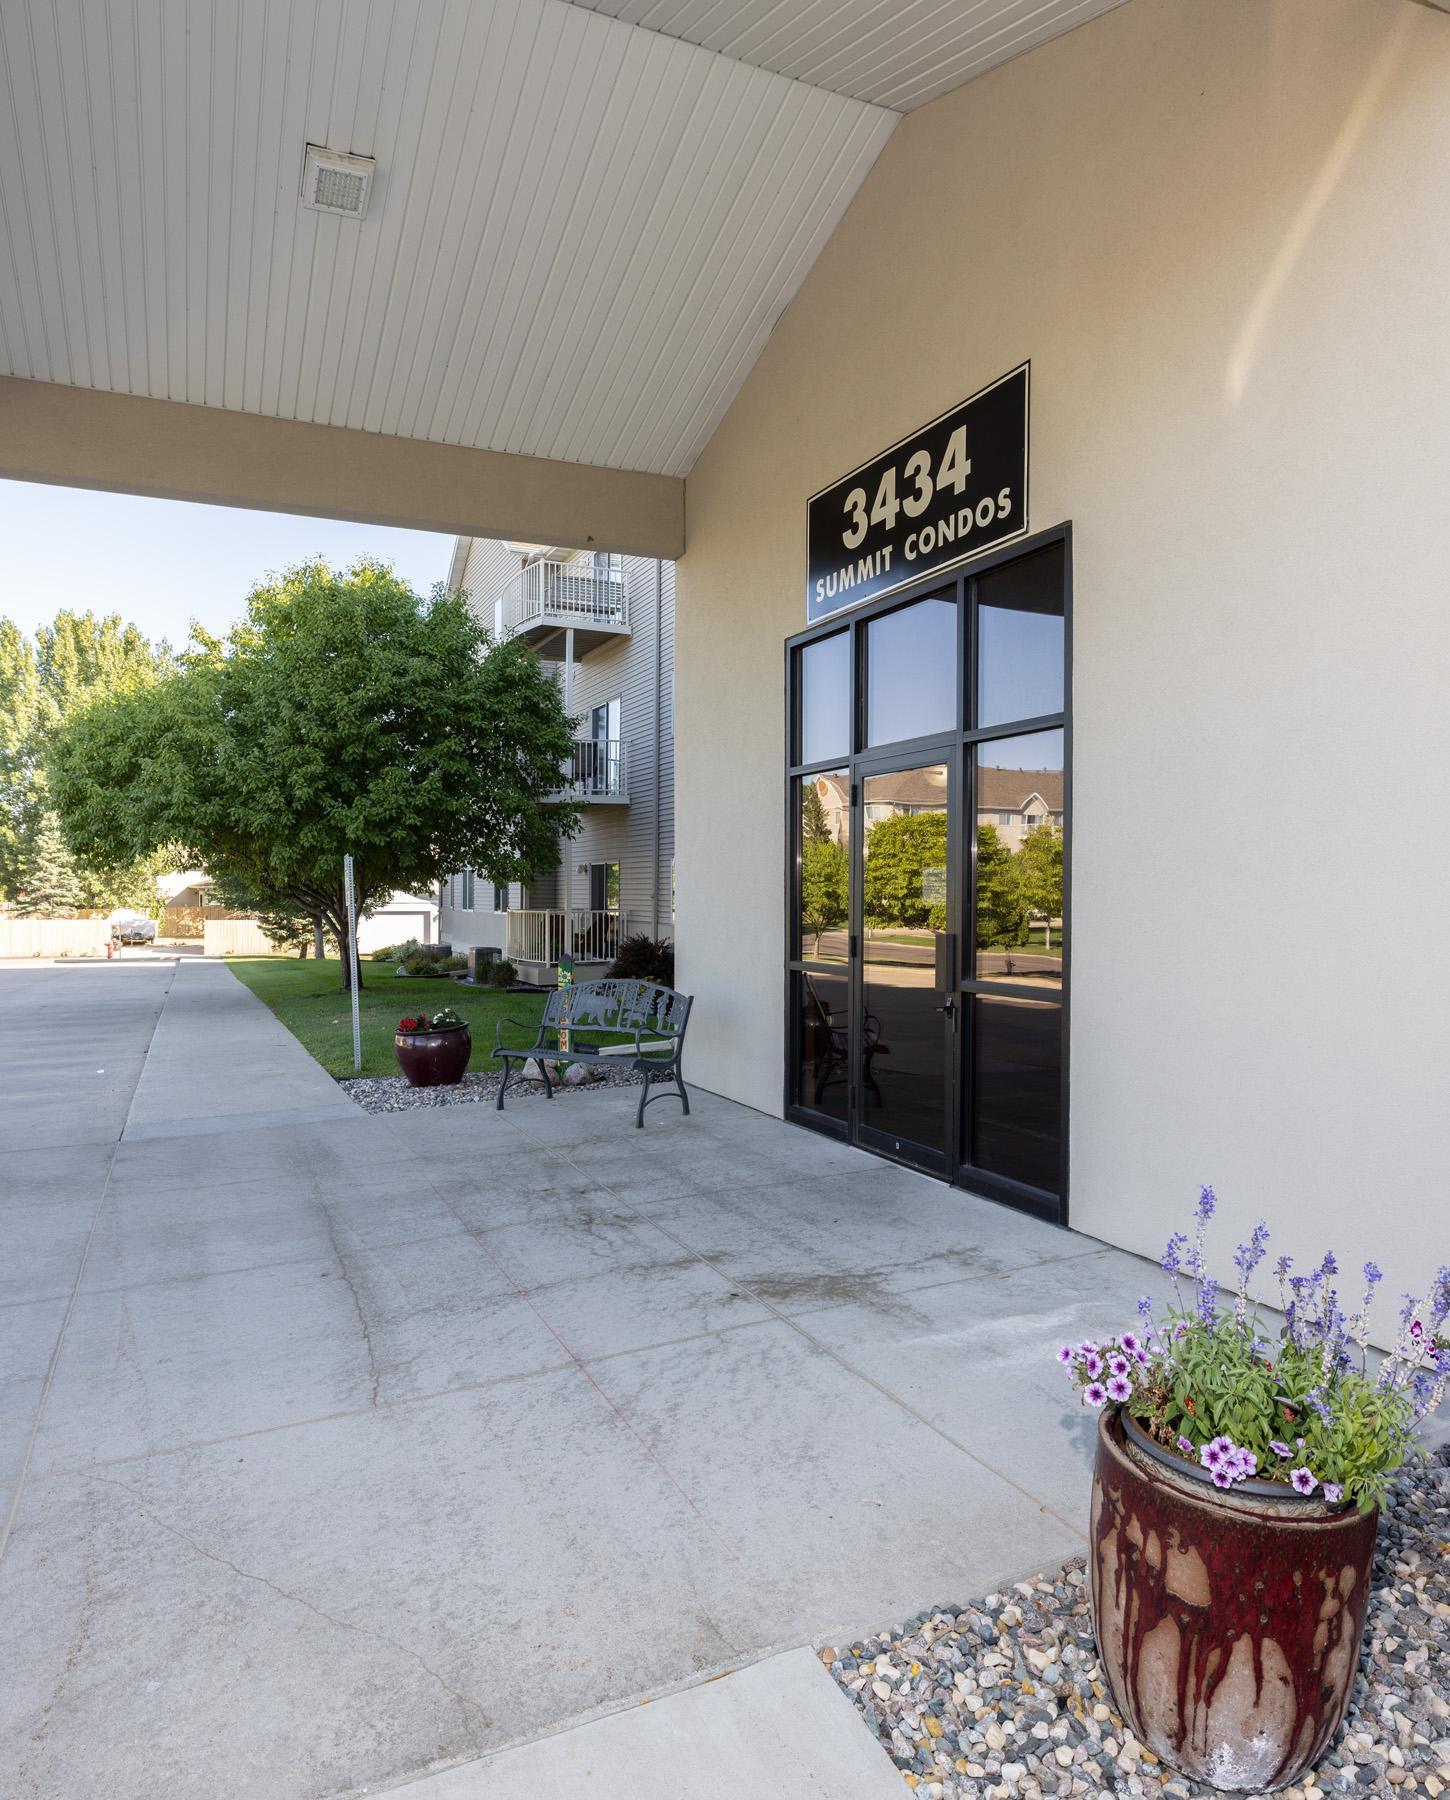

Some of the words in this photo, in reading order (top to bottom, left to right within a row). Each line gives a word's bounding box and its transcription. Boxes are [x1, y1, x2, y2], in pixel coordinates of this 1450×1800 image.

[815, 545, 893, 603] SUMMIT
[904, 487, 1012, 560] CONDOS
[842, 424, 971, 549] 3434
